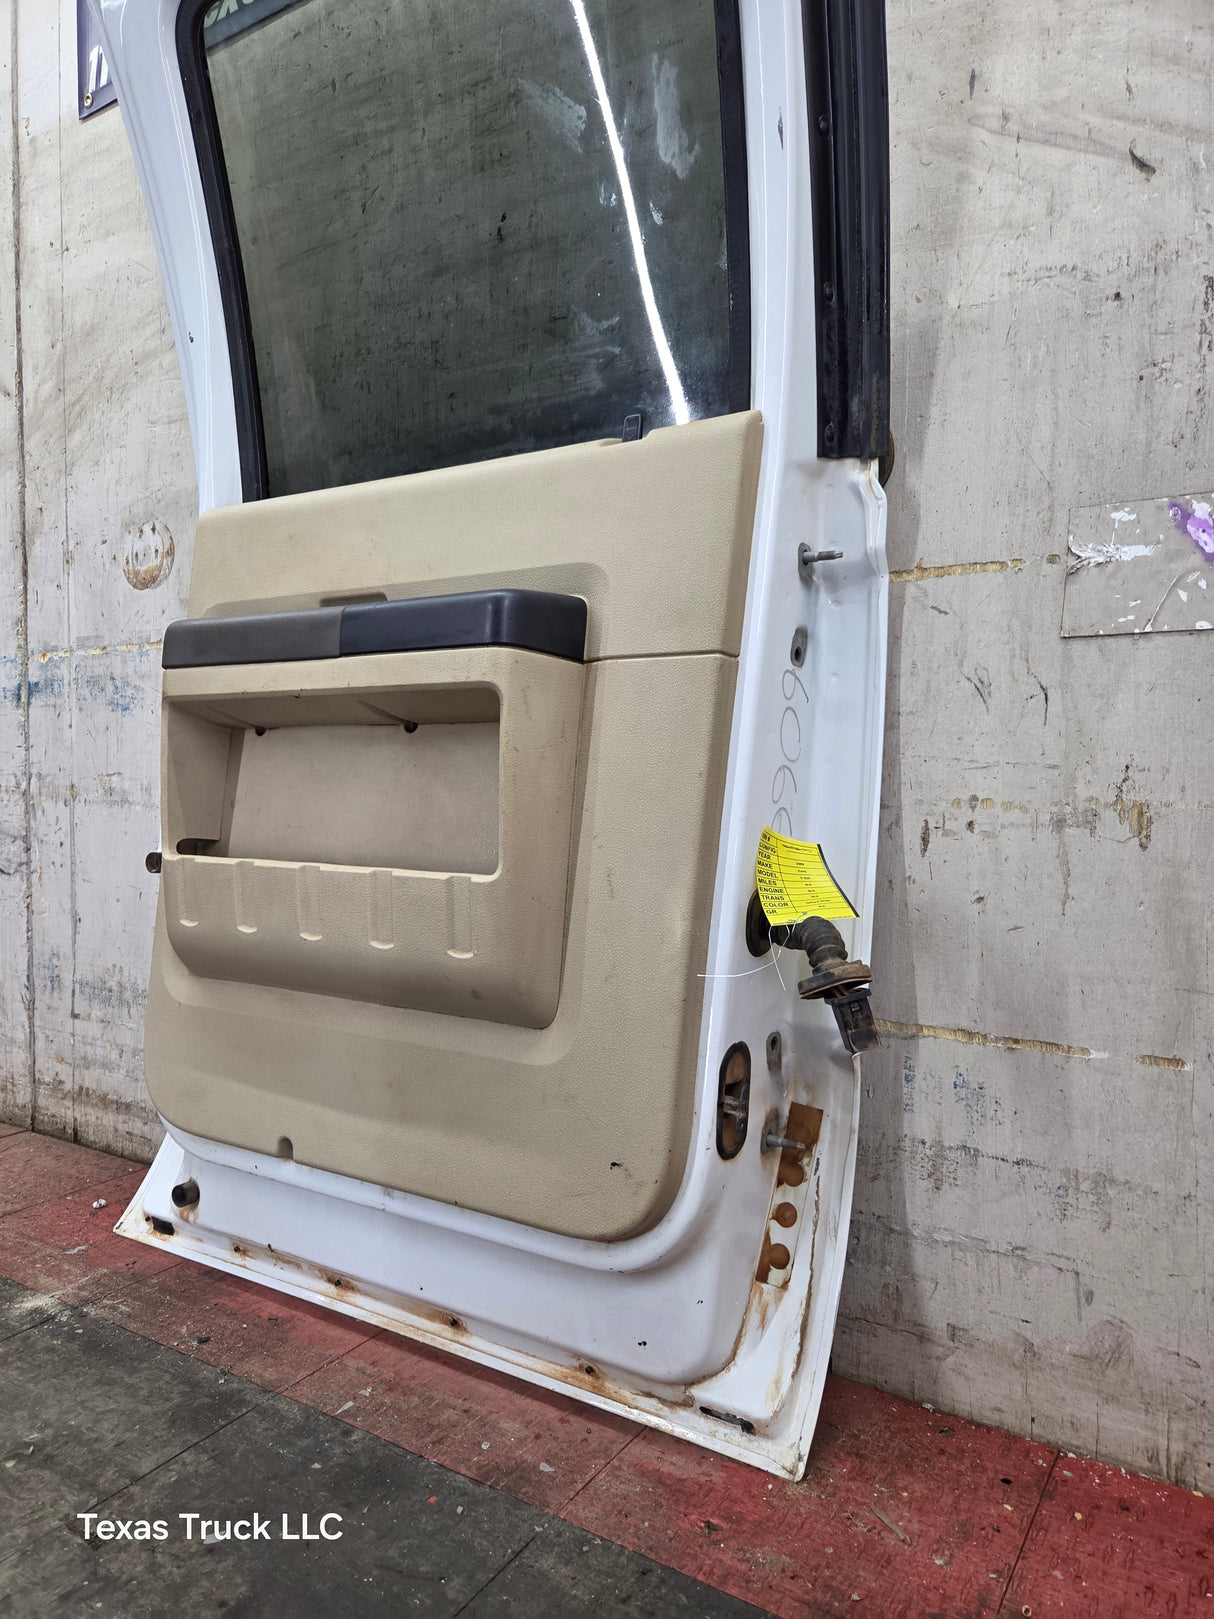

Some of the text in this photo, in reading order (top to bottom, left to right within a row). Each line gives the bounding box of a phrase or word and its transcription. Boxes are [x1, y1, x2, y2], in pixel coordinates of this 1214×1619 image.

[758, 851, 772, 861] YEAR
[757, 860, 773, 869] MAKE
[757, 869, 779, 879] MODEL
[758, 878, 777, 886] MILES
[759, 886, 785, 894] ENGINE
